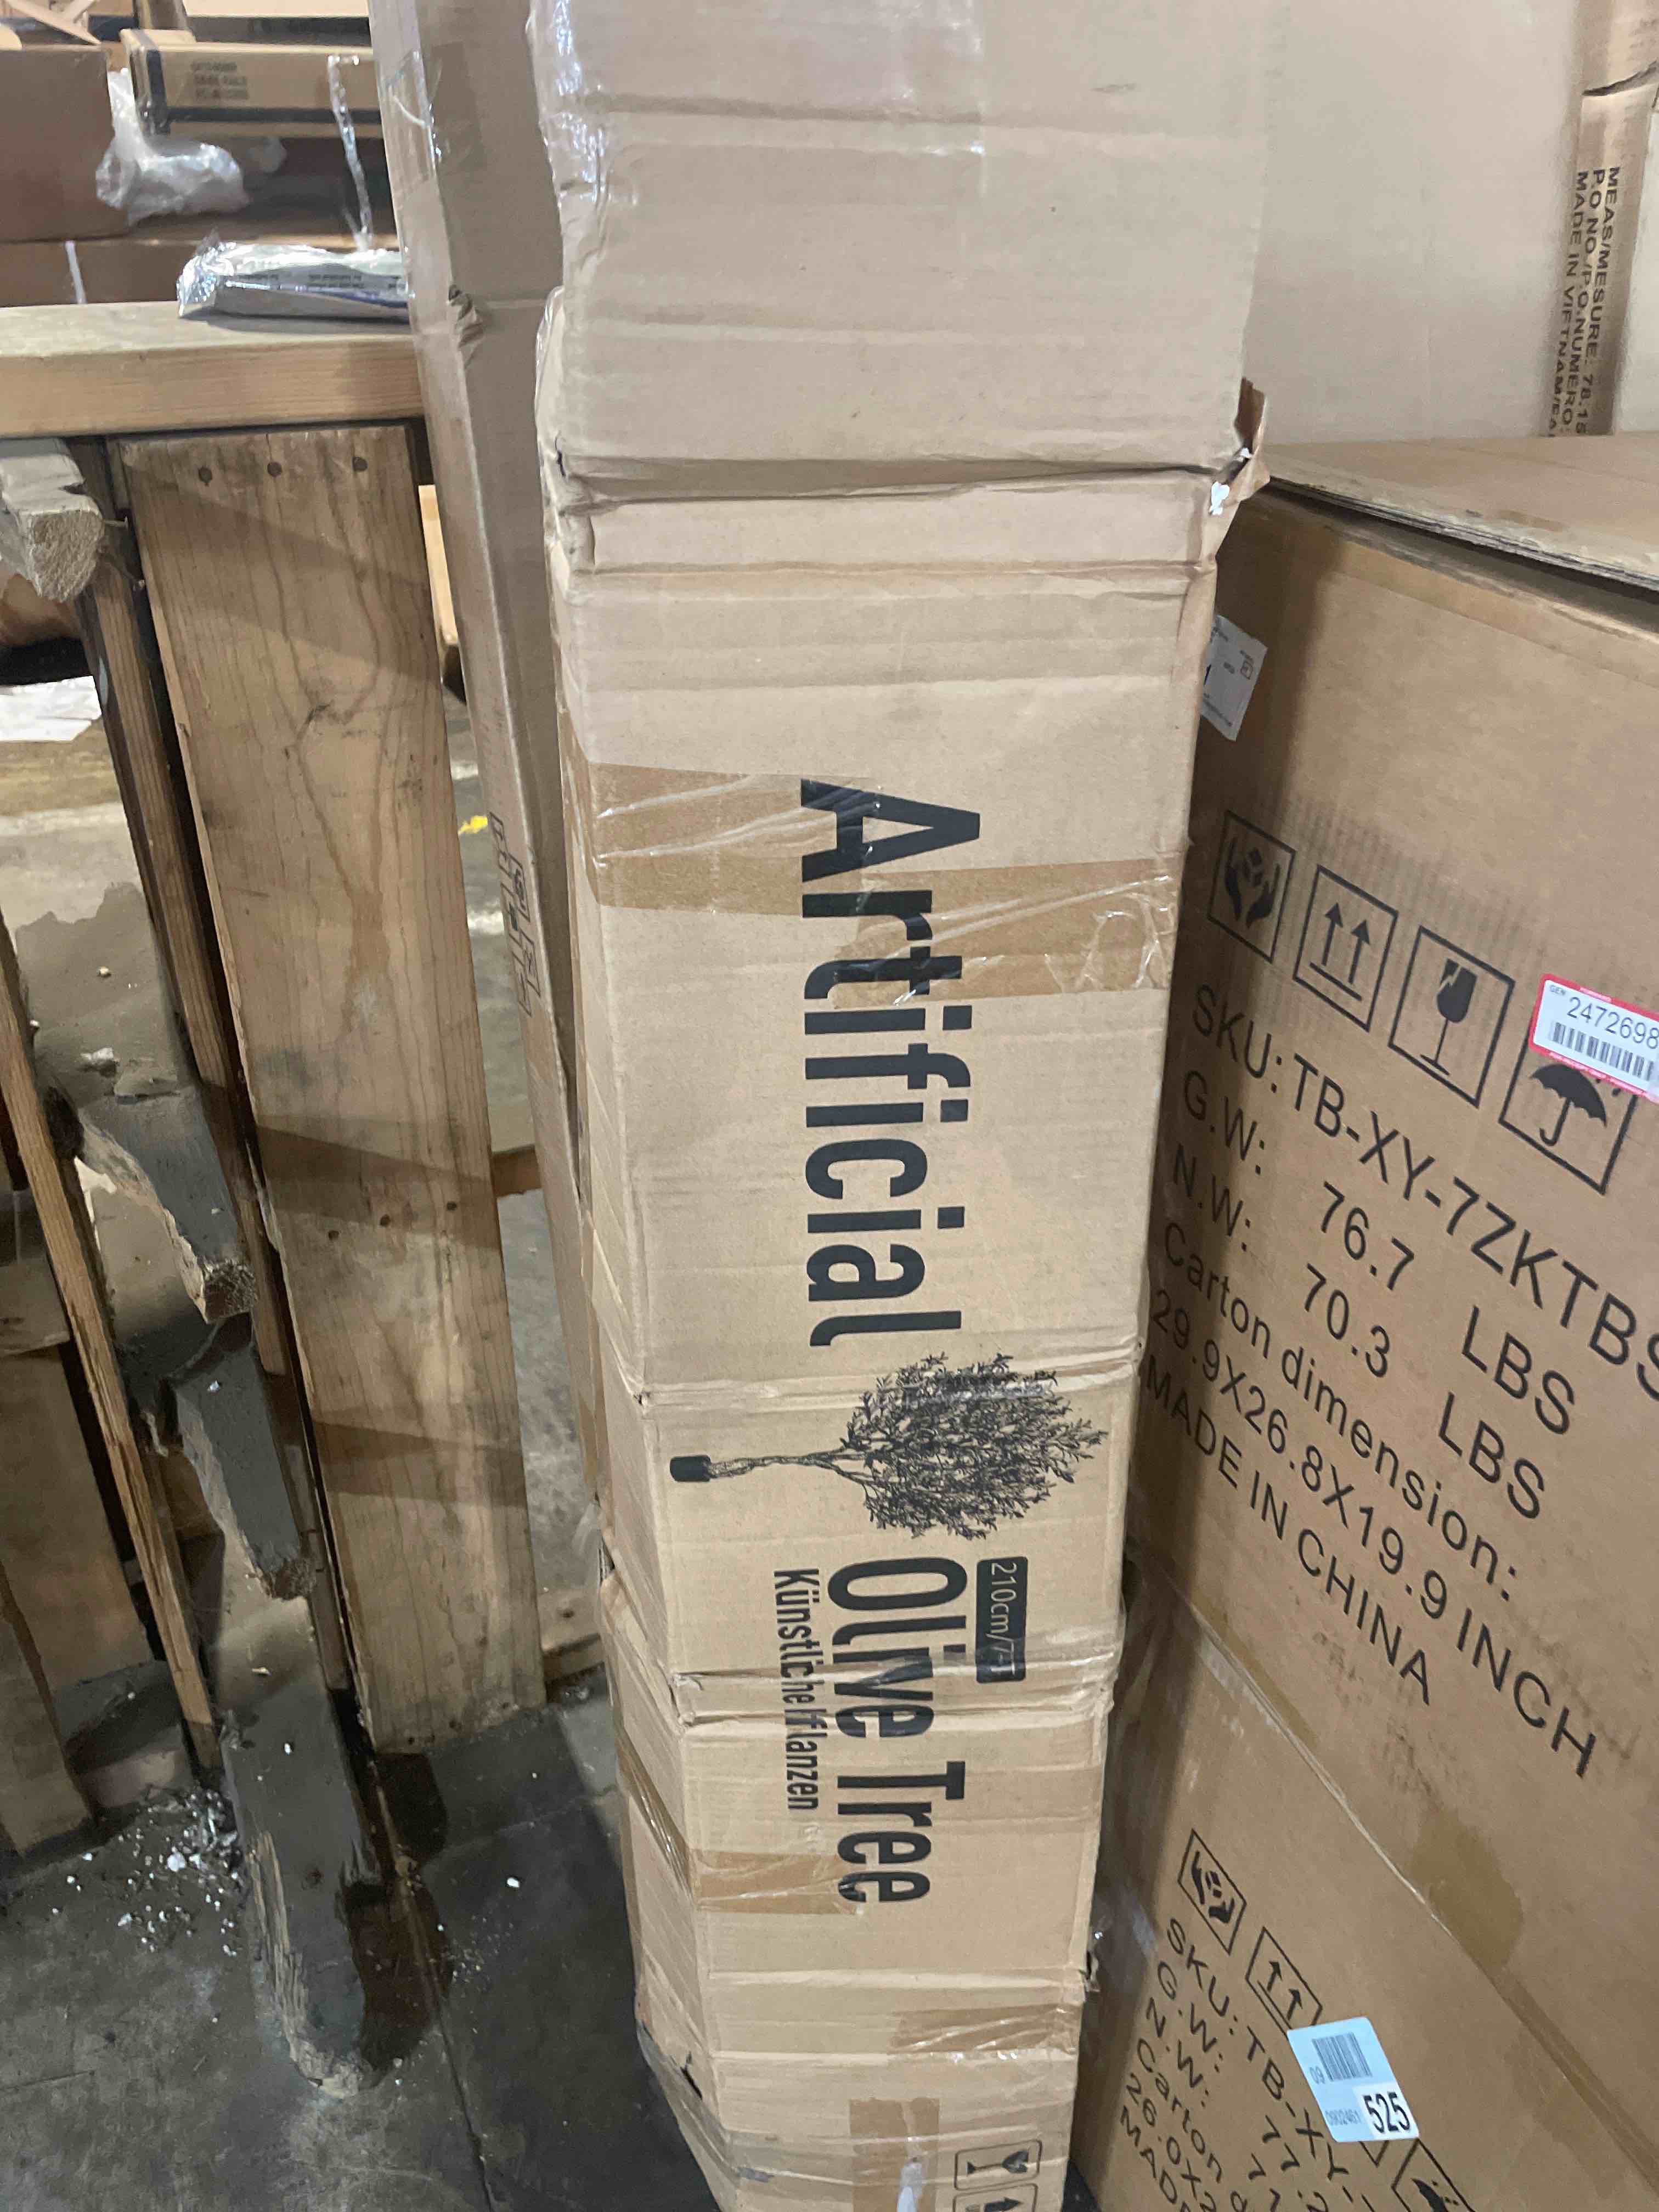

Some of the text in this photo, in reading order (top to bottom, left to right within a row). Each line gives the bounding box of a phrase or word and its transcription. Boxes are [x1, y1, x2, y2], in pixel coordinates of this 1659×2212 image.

[1566, 253, 1580, 276] IN
[1570, 171, 1589, 246] MADE
[800, 778, 981, 1347] Artificial
[1567, 996, 1659, 1049] 2472698
[1184, 1070, 1576, 1435] G.W: 76.7 LBS
[1173, 1143, 1545, 1520] N.W: 70.3 LBS
[1164, 1222, 1517, 1602] Carton dimension:
[1147, 1354, 1430, 1706] MADE IN CHINA
[1153, 1289, 1596, 1779] 29.9X26.8X19.9 INCH
[774, 1568, 824, 1705] Künstliche
[827, 1556, 968, 1903] Olive Tree
[1146, 1997, 1209, 2107] N.W:
[1157, 1960, 1224, 2073] G.W:
[1137, 2038, 1222, 2184] Carton
[1362, 2091, 1412, 2134] 525
